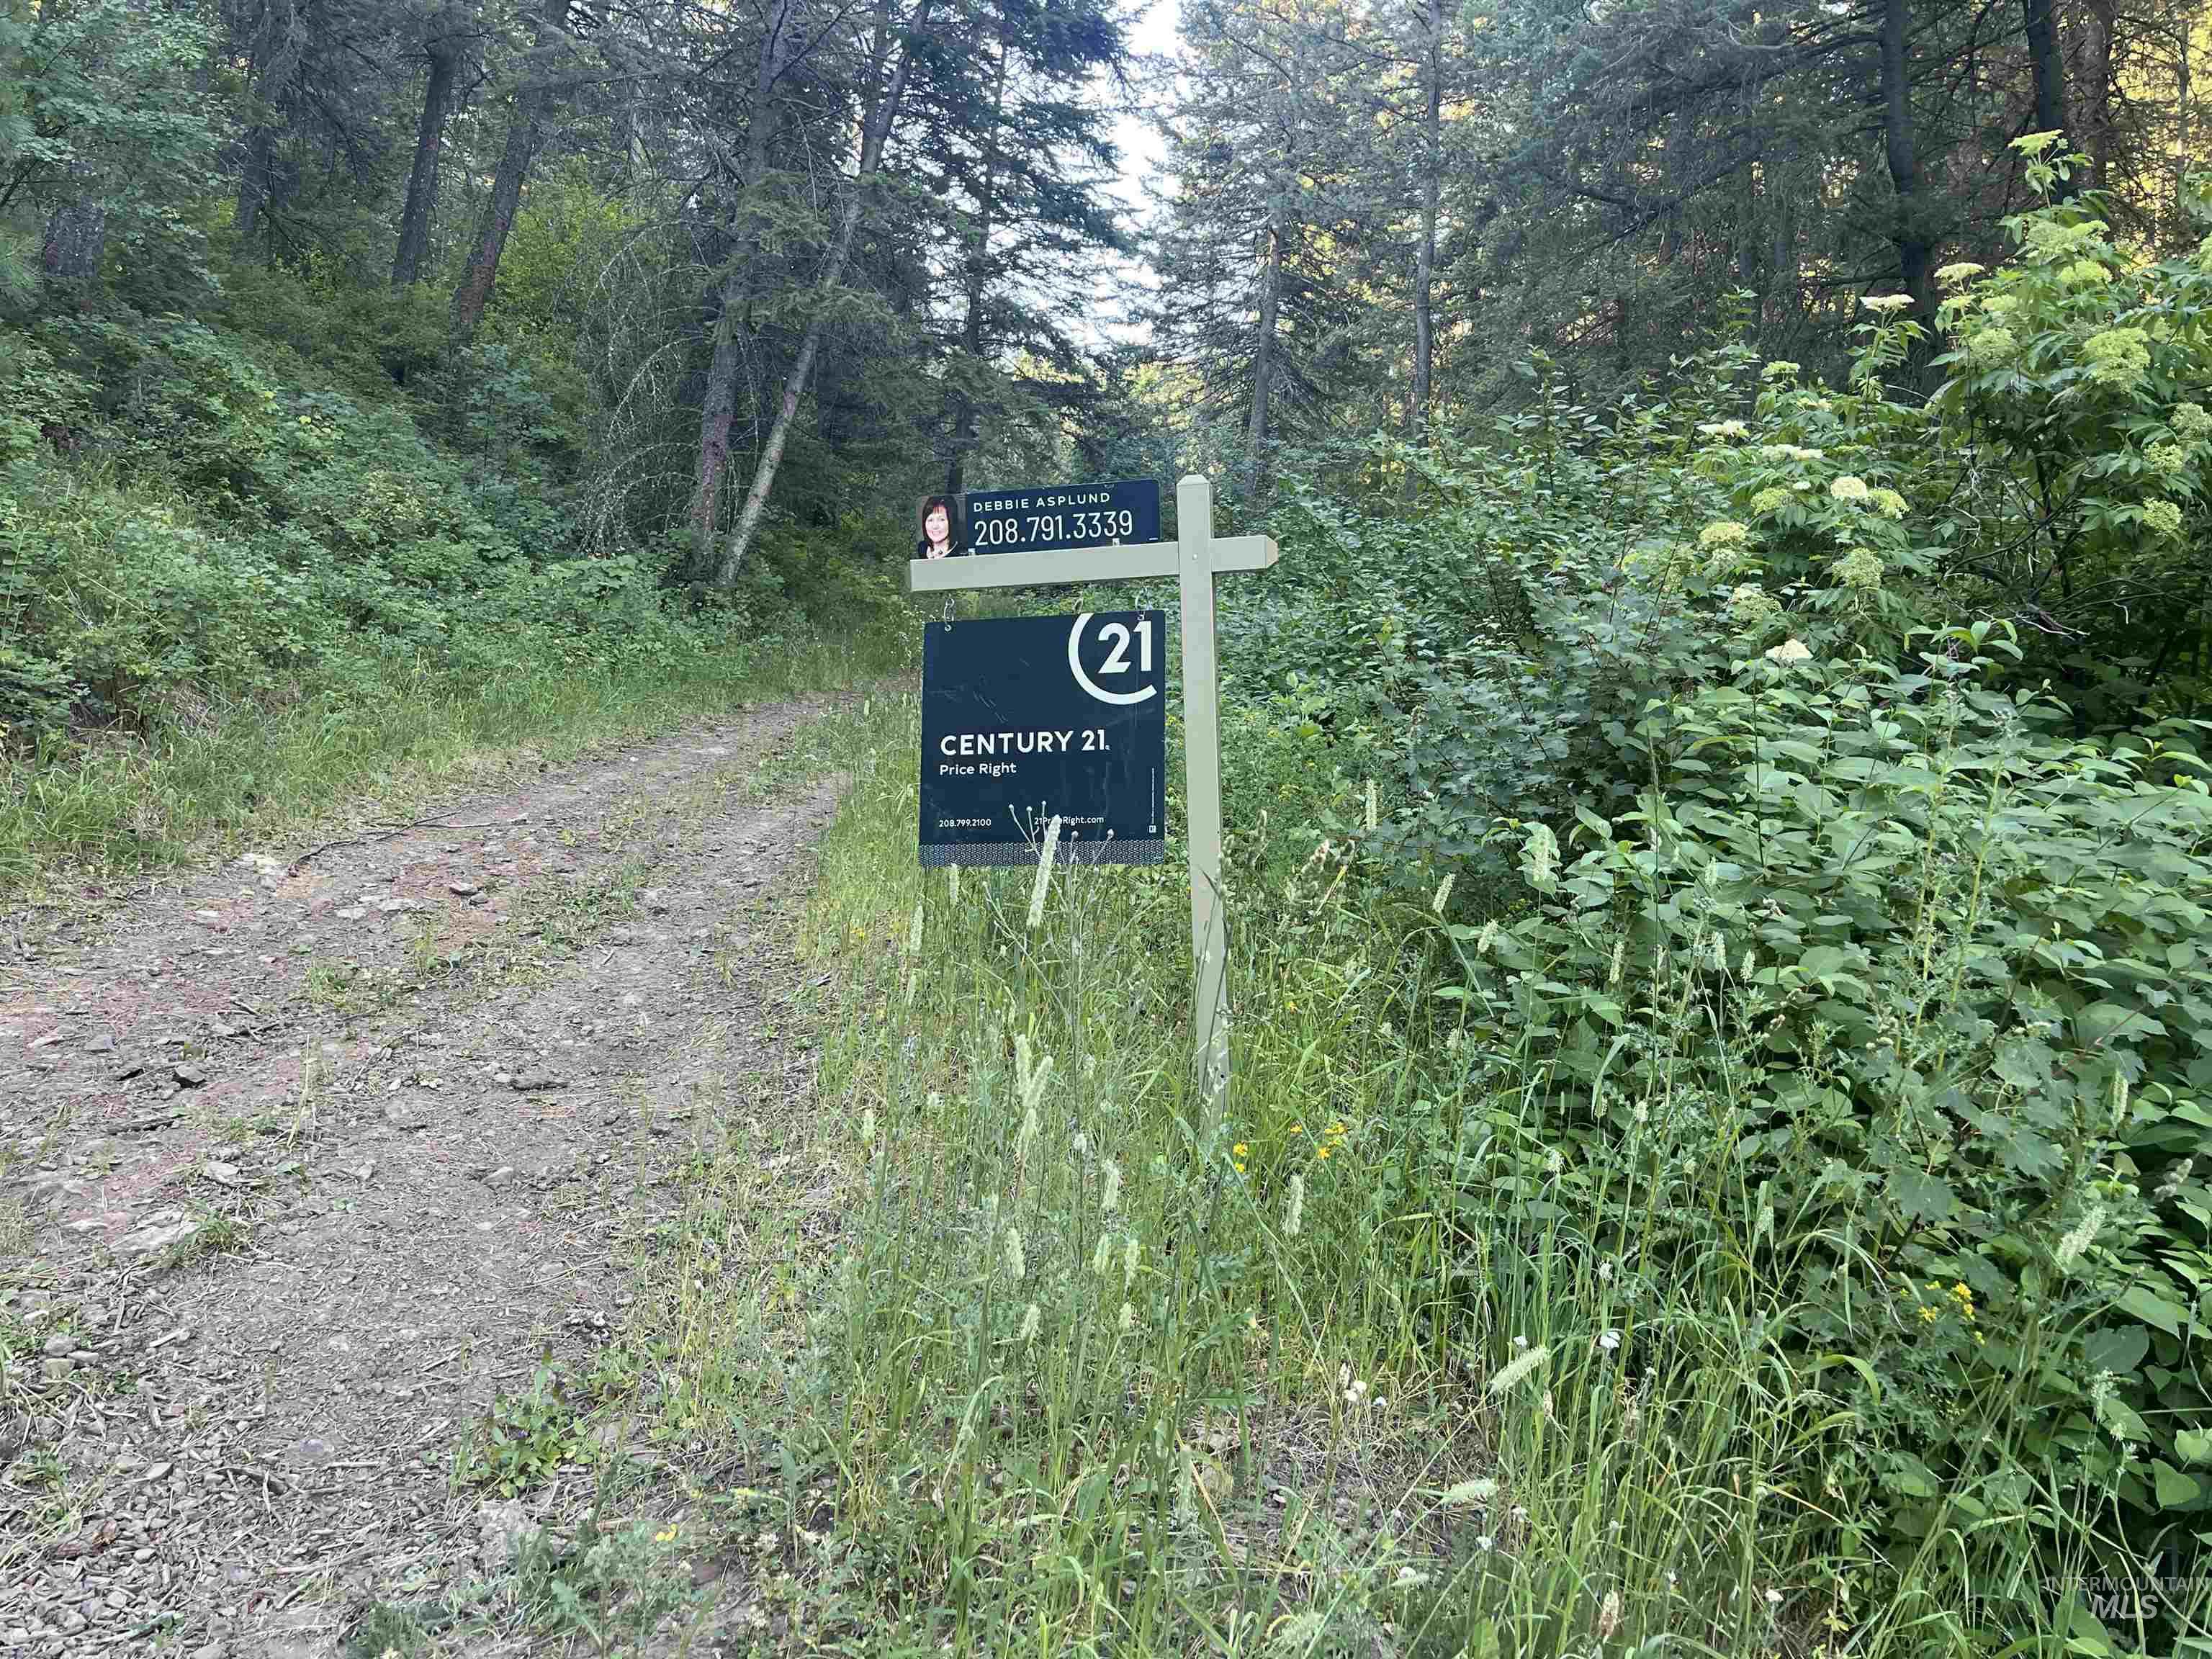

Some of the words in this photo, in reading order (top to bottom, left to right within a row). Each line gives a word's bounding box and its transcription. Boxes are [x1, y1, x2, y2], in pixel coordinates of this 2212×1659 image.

[974, 498, 1029, 512] DEBBIE
[1036, 493, 1110, 507] ASPLUND
[974, 510, 1133, 546] 208.791.3339
[940, 730, 1074, 755] CENTURY
[940, 764, 974, 775] Price
[979, 762, 1017, 777] Right
[938, 818, 992, 827] 208.799.2100
